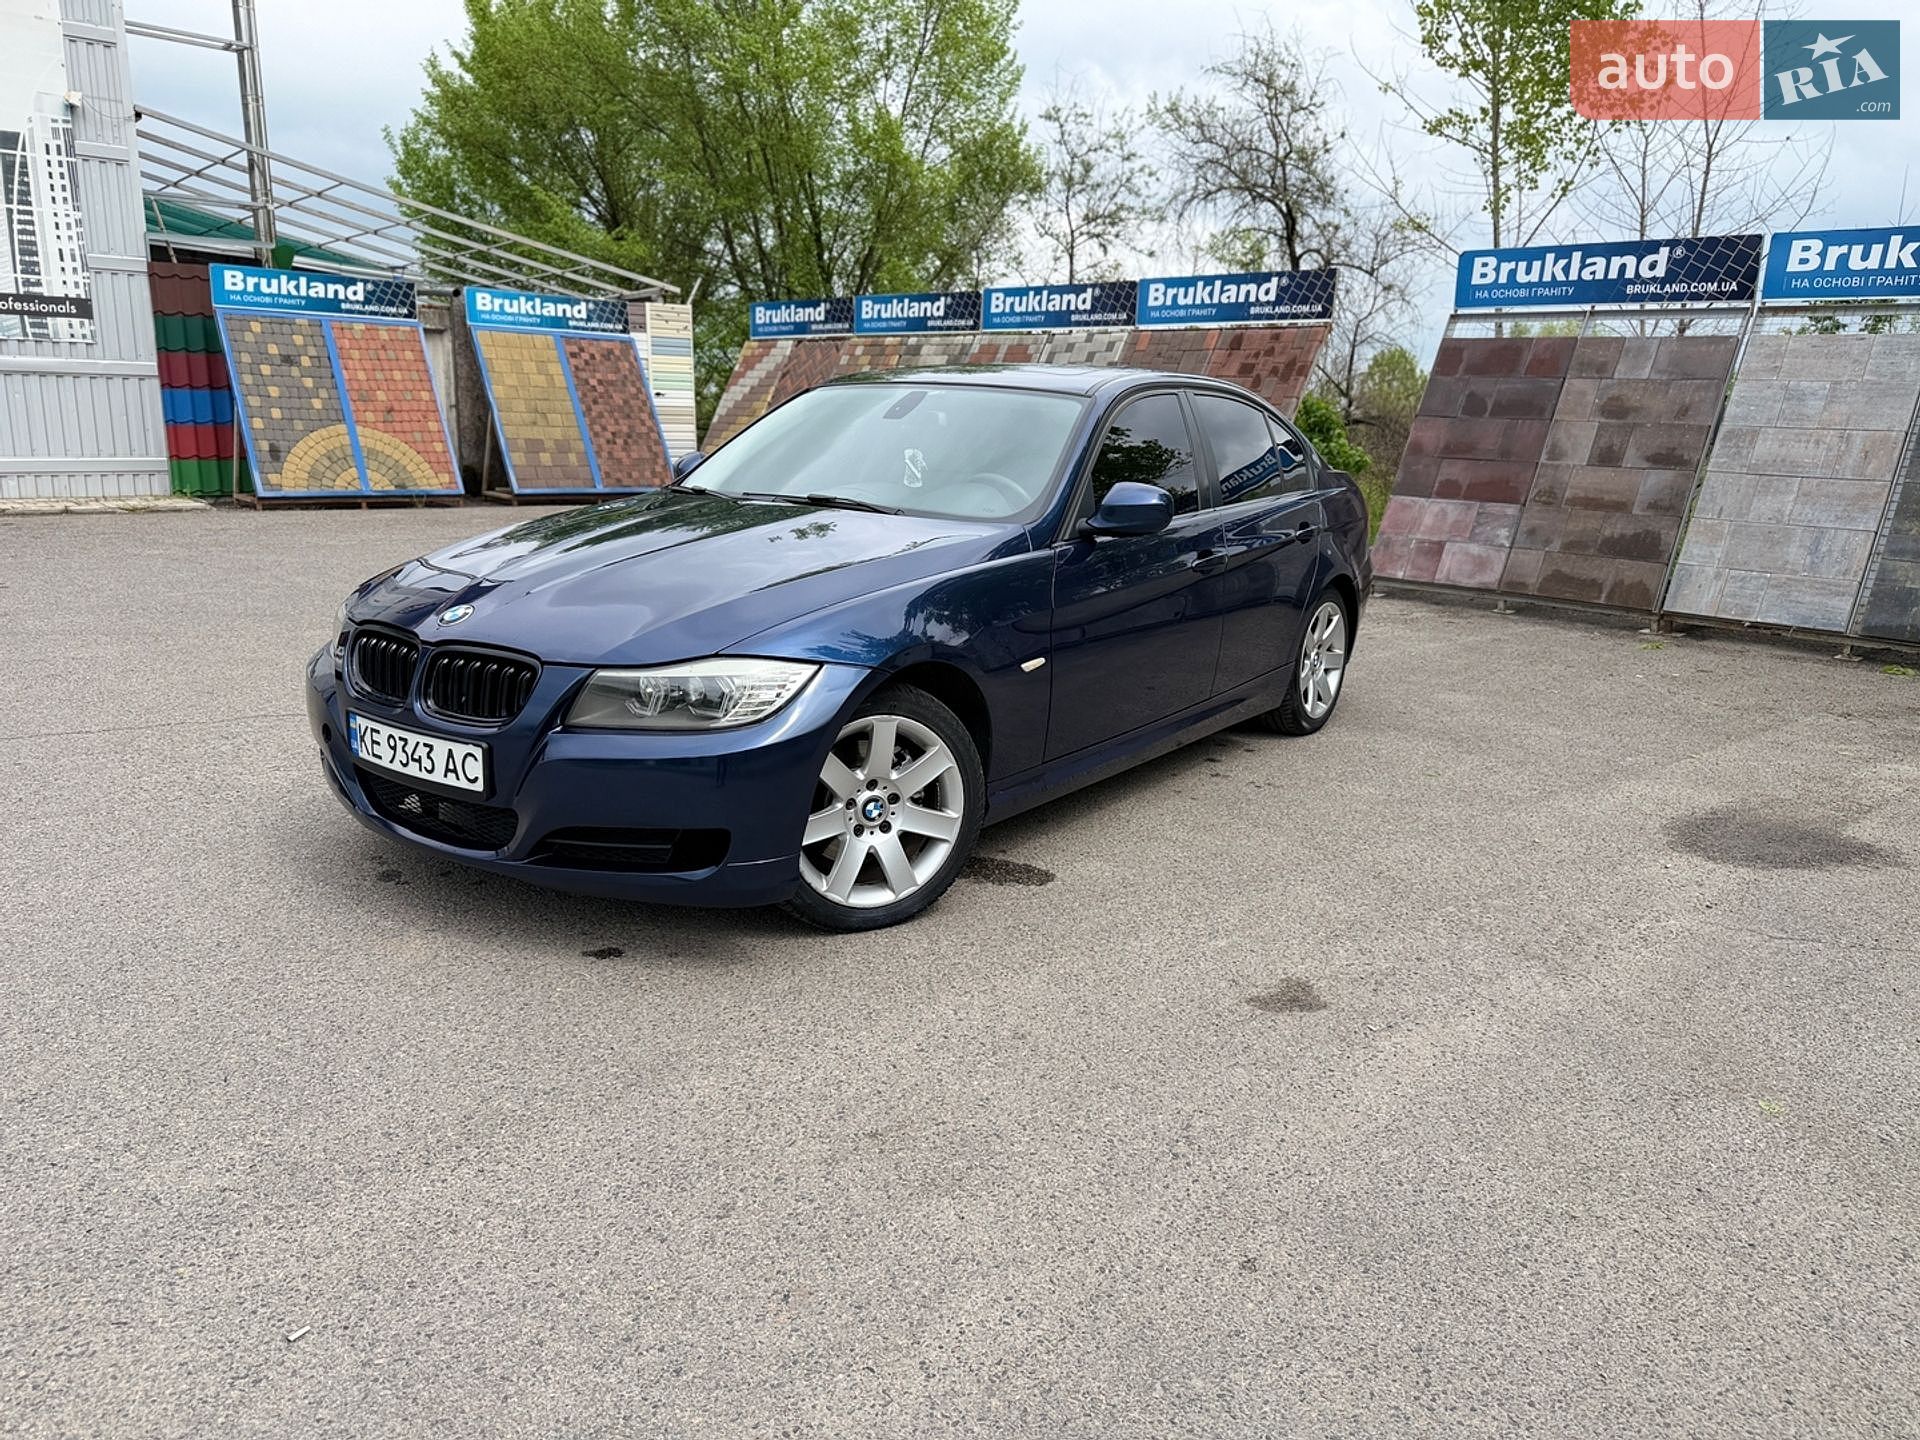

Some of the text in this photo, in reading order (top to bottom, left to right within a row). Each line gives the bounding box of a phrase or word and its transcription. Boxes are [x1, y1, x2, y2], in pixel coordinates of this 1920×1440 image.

[1785, 233, 1920, 272] Bruk
[1626, 281, 1738, 295] BRUKLAND.COM.UA
[1791, 277, 1810, 289] НА
[1813, 276, 1865, 288] ОСНОВІ
[1475, 286, 1575, 299] НА ОСНОВІ ГРАНІТУ
[341, 302, 409, 315] BRUKLAND.COM.UA
[358, 722, 383, 760] KE
[387, 733, 436, 775] 9343
[443, 748, 479, 784] AC
